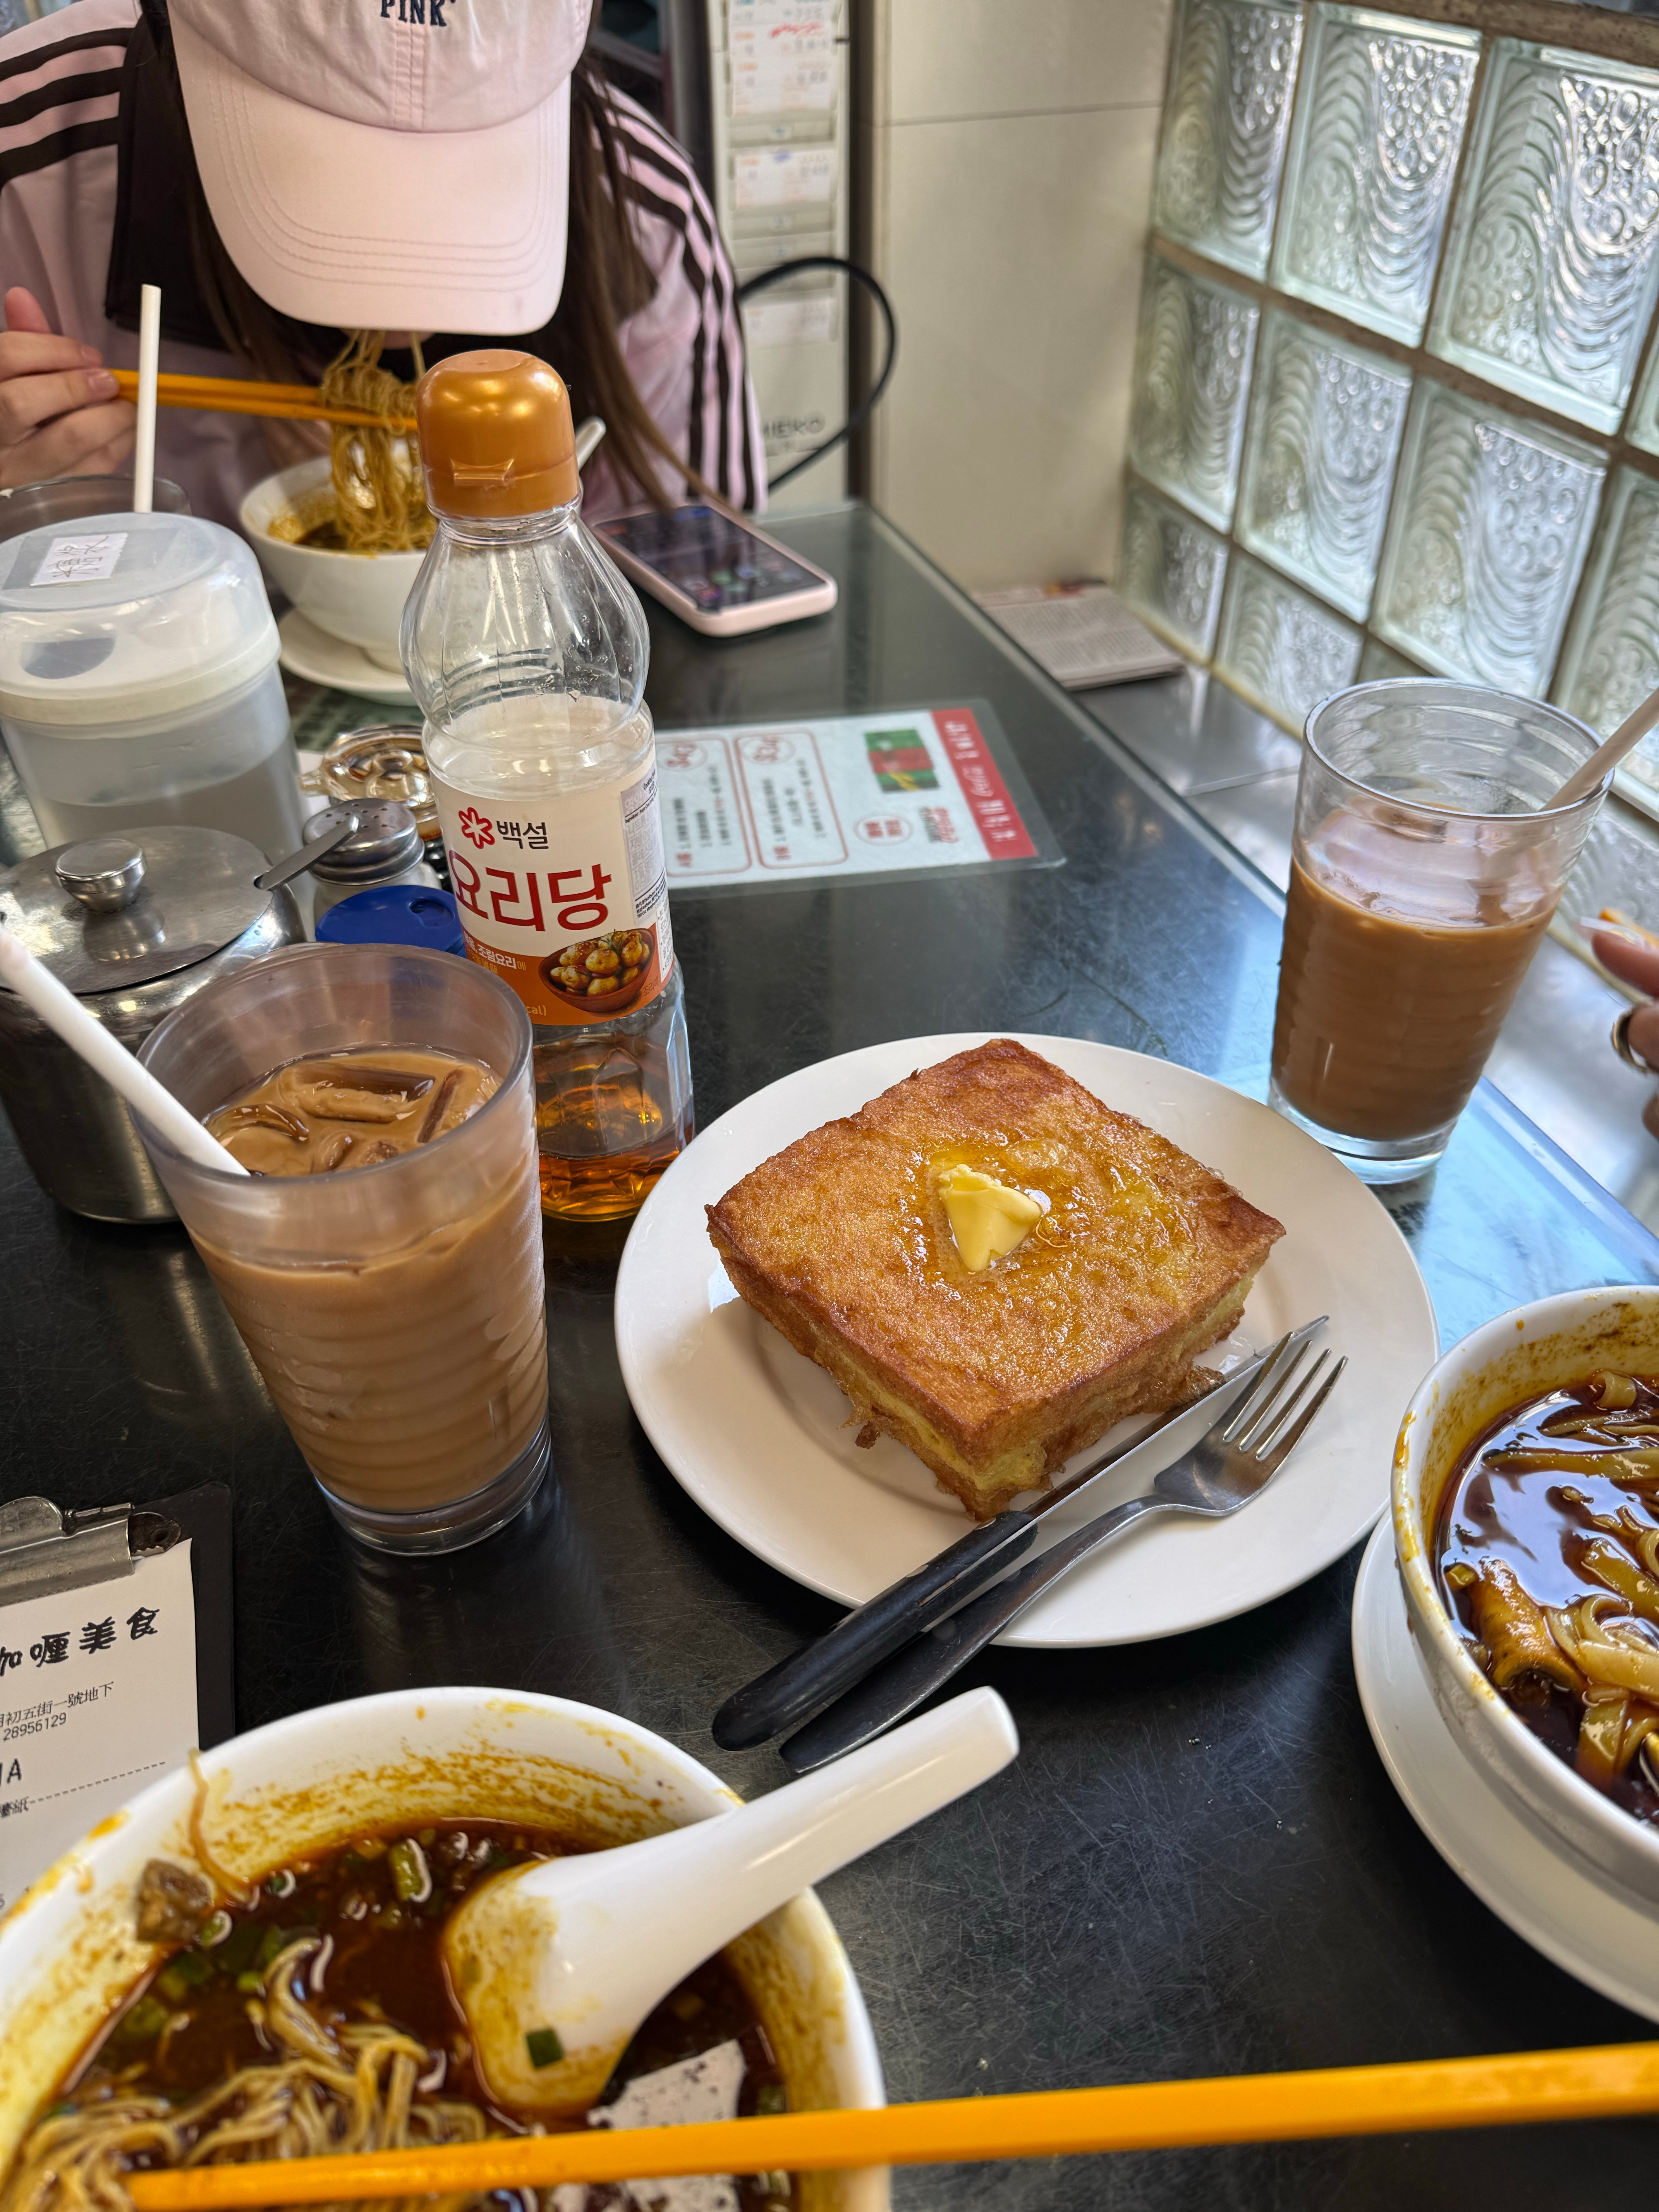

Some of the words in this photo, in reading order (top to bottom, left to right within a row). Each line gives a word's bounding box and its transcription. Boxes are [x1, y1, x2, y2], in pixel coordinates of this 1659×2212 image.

[380, 0, 447, 26] PINK
[496, 820, 549, 849] 백설
[449, 849, 612, 932] 요리당
[526, 1005, 547, 1016] cal)
[3, 1712, 67, 1741] 28956129
